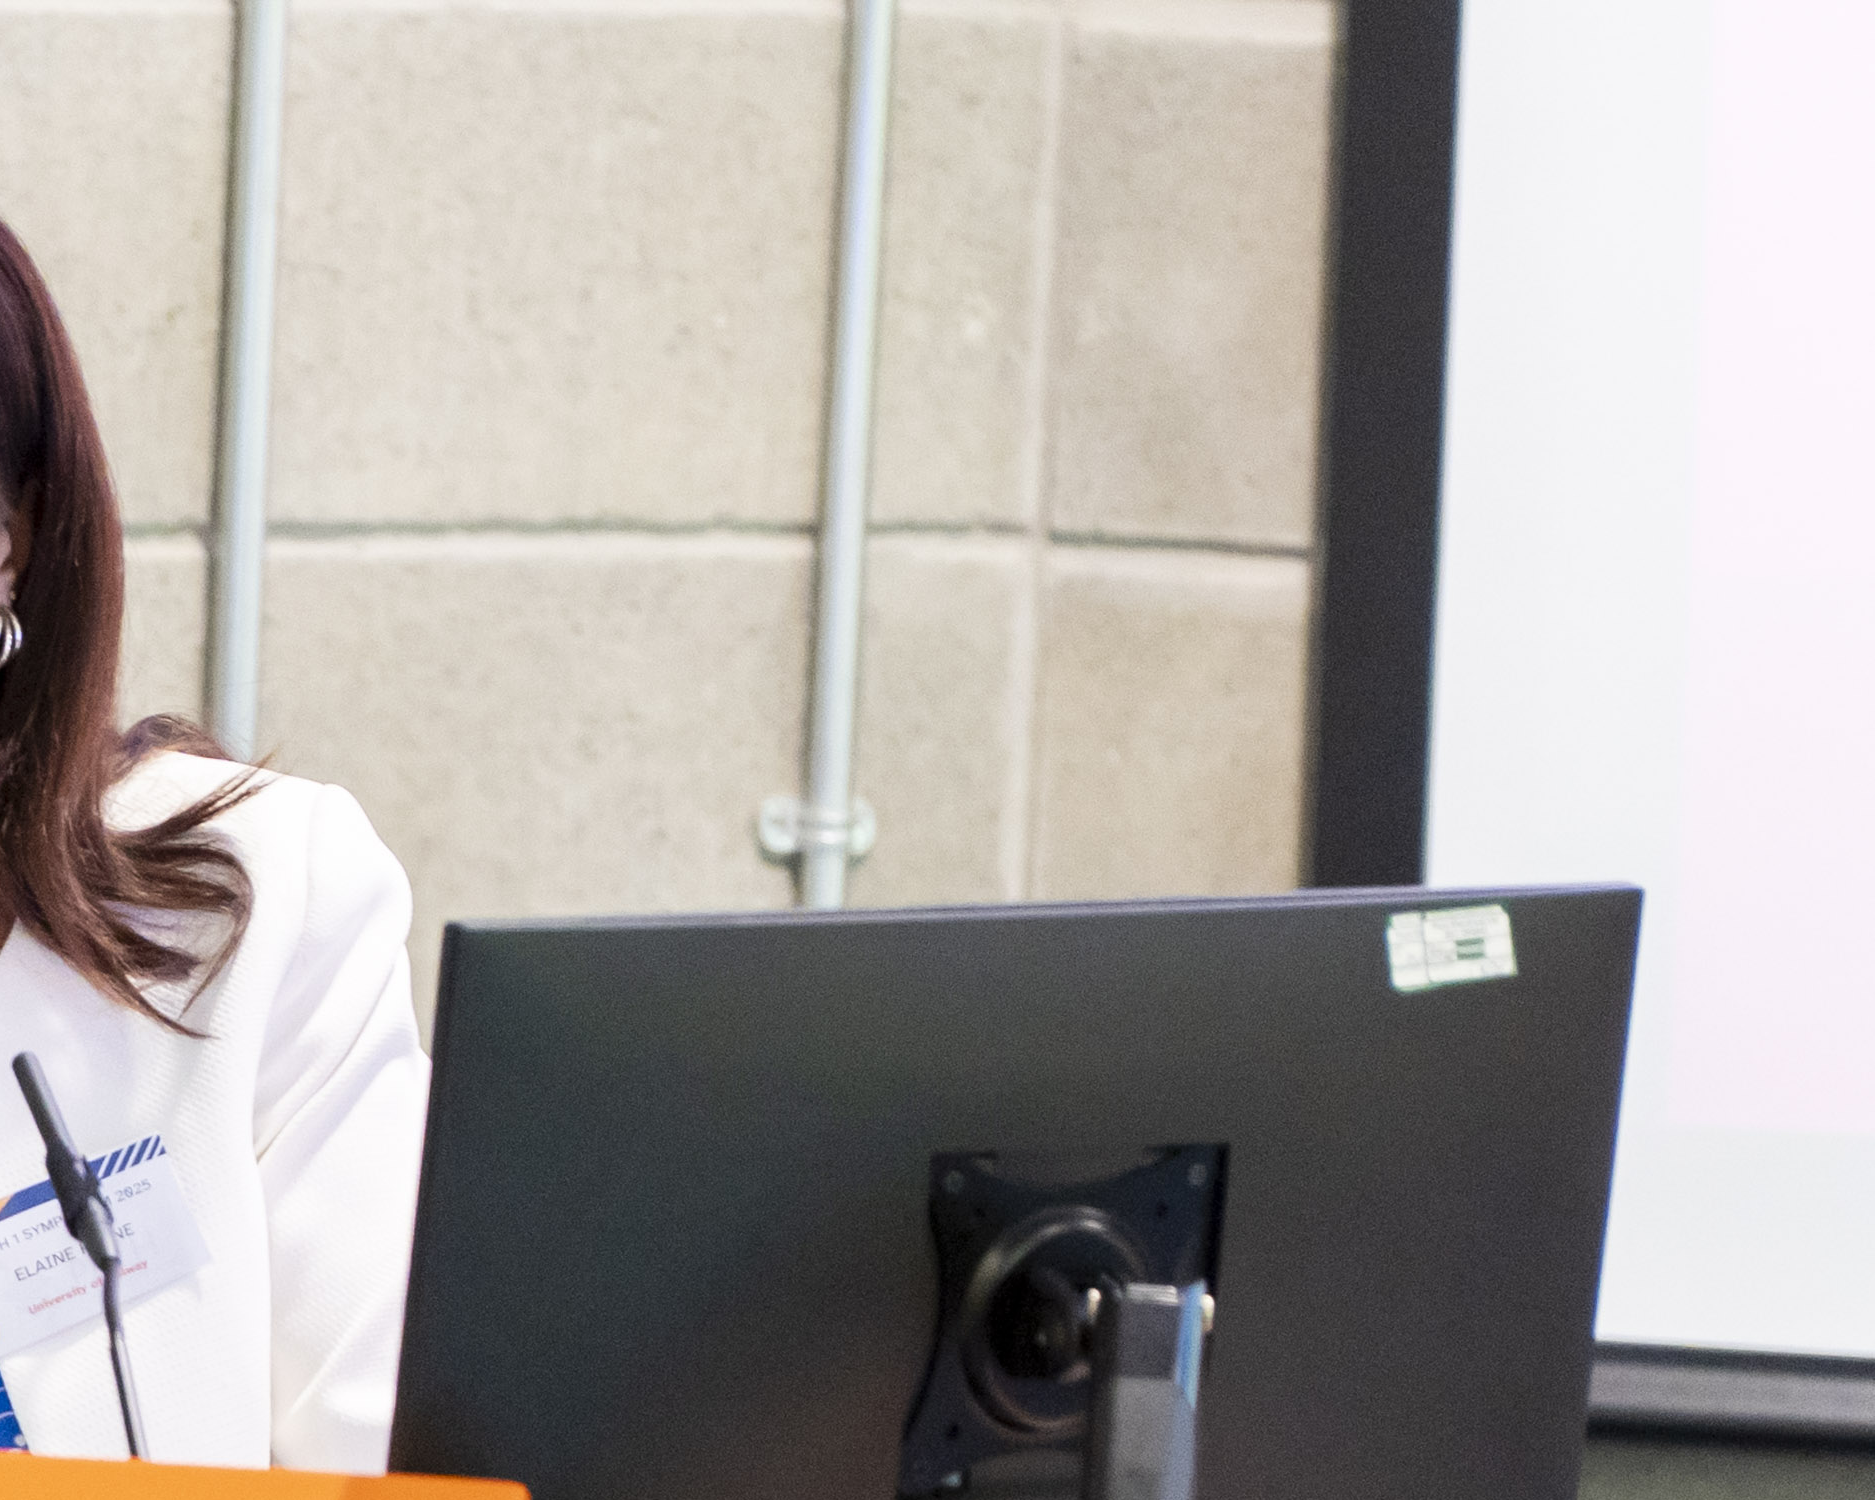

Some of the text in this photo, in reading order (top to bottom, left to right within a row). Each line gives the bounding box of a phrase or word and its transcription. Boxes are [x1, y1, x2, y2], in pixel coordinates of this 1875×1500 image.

[114, 1178, 152, 1203] 2025
[14, 1246, 77, 1282] ELAINE
[28, 1285, 87, 1315] University
